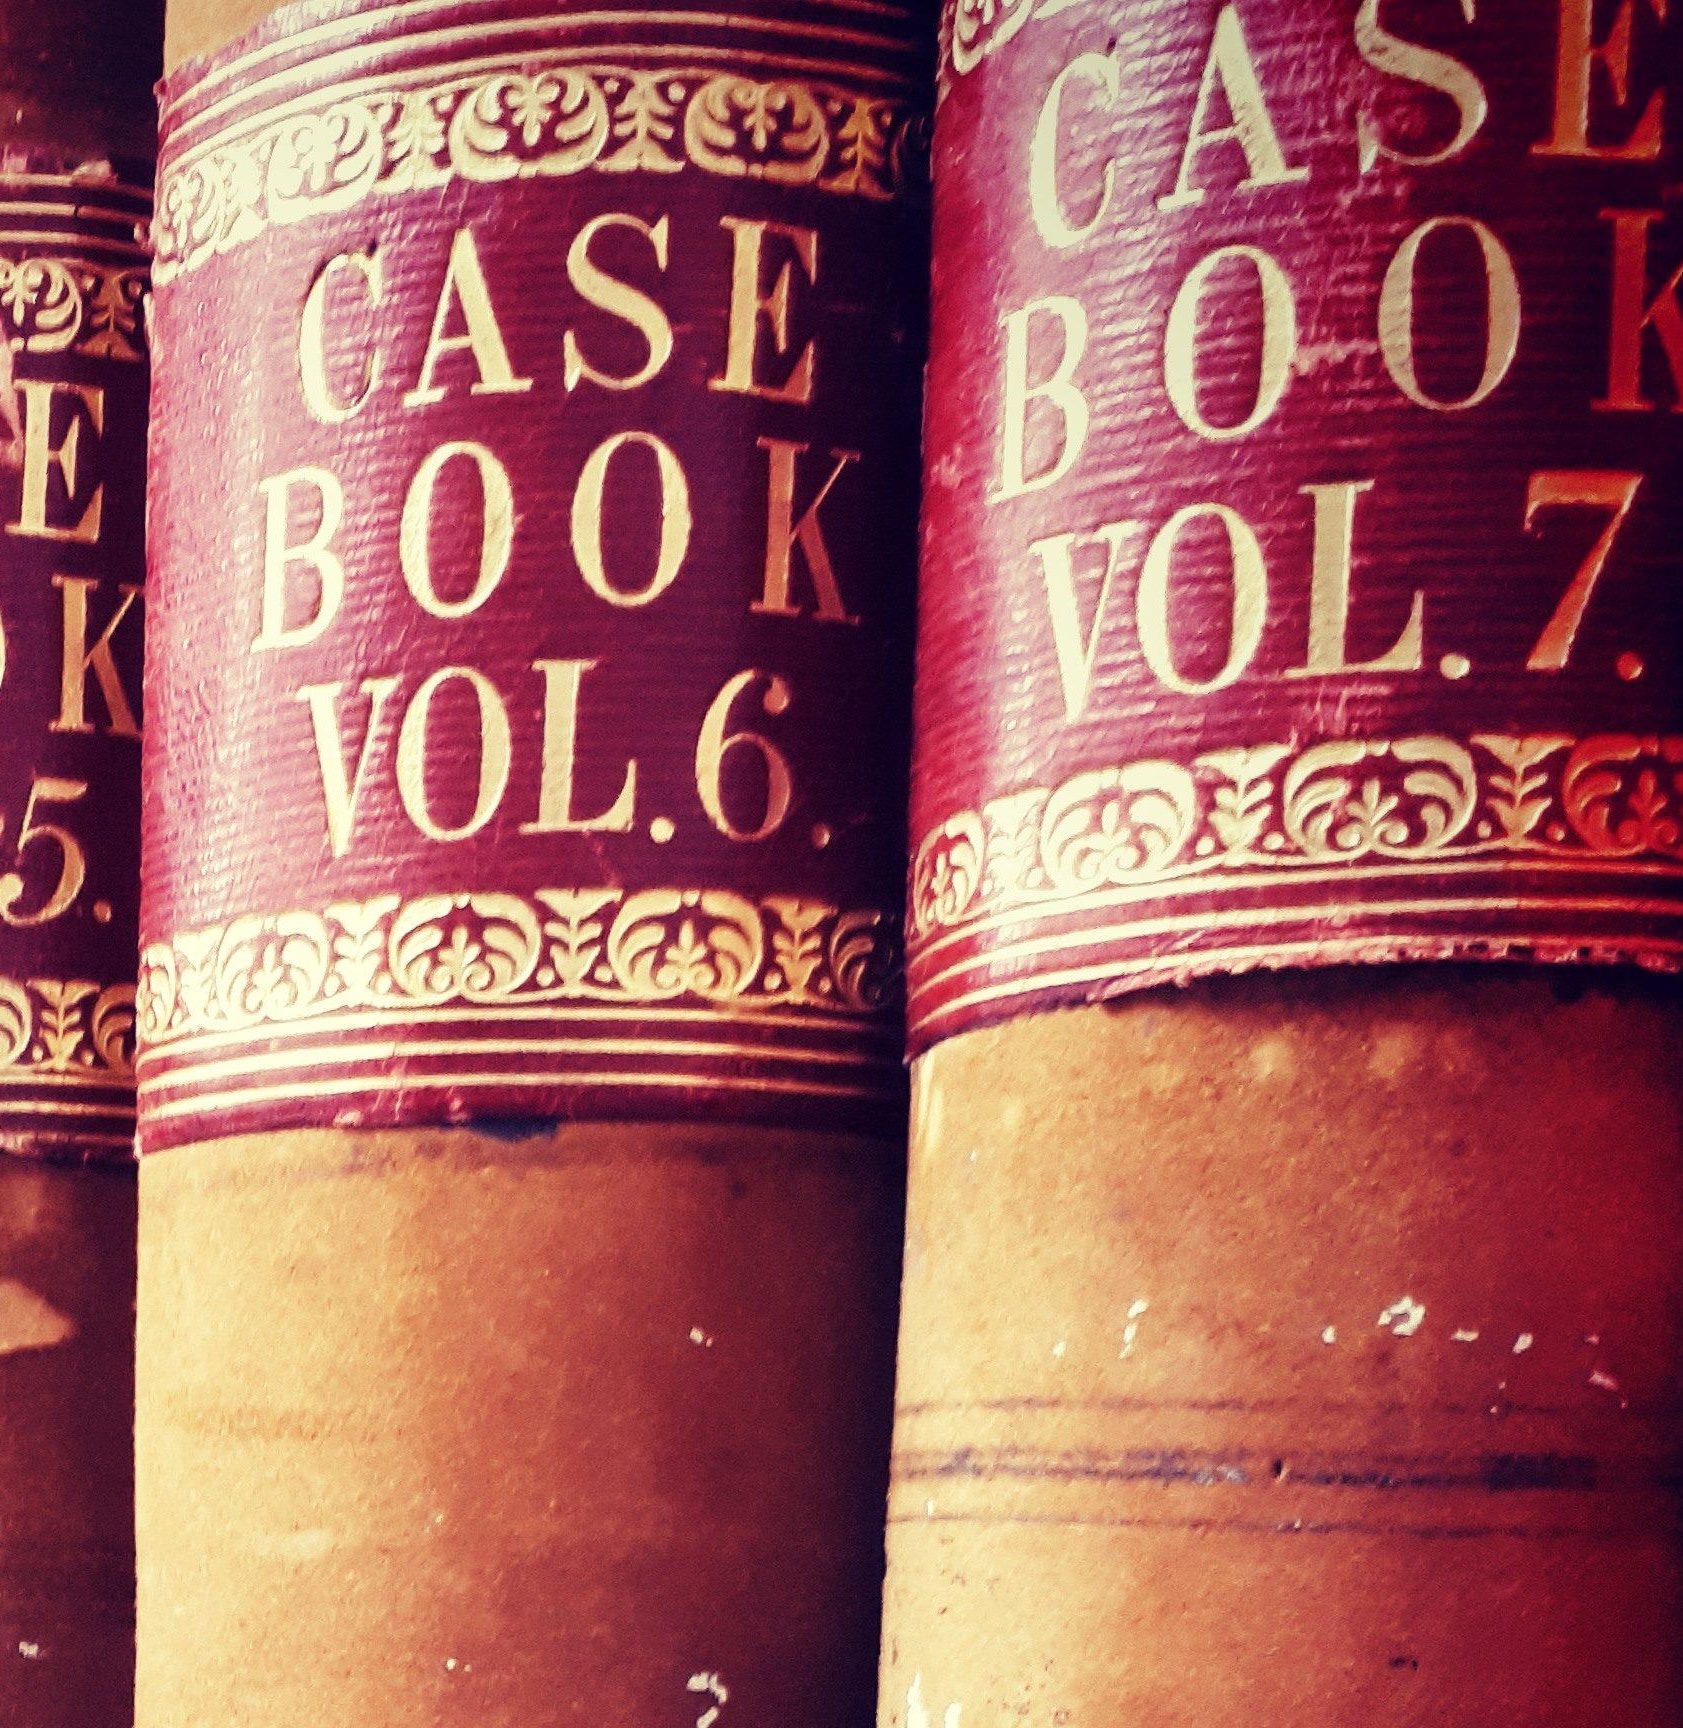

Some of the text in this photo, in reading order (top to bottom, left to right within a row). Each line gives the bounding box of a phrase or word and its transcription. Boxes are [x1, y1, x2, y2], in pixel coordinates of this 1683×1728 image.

[1028, 0, 1668, 253] CASE
[297, 211, 820, 427] CASE
[986, 207, 1683, 506] BOOK
[251, 430, 862, 655] BOOK
